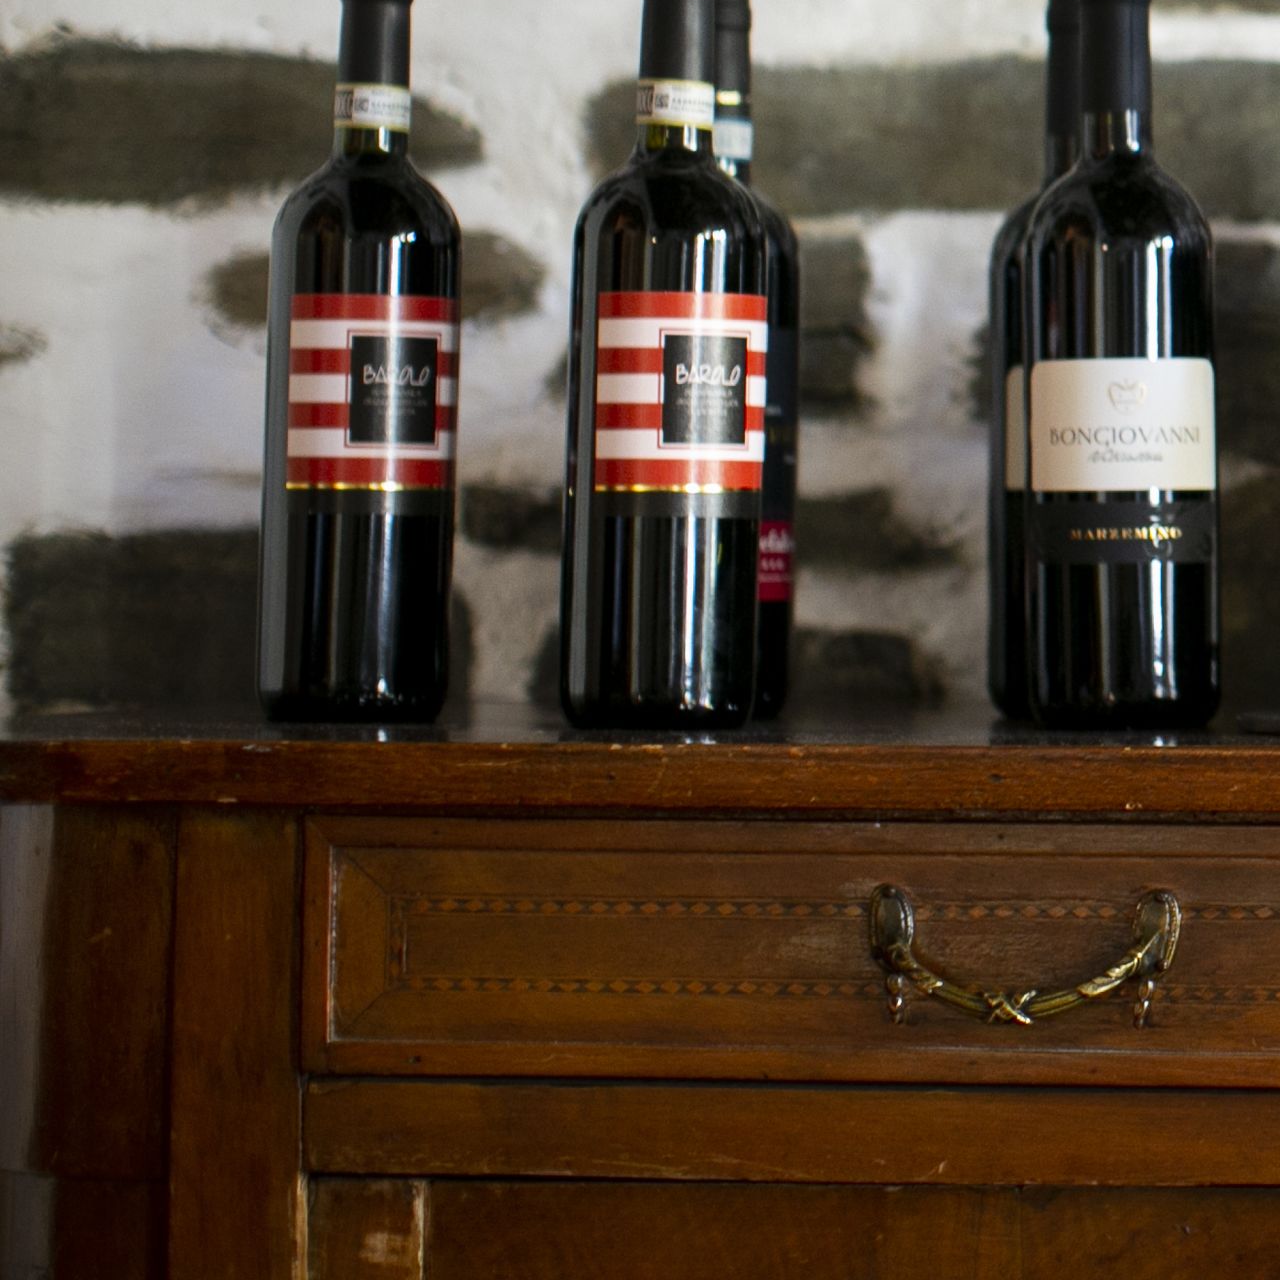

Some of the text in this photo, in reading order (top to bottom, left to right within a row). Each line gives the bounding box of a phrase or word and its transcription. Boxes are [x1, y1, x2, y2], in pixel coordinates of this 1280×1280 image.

[362, 363, 431, 387] BAOLO
[675, 362, 742, 387] BAROLO
[1049, 426, 1201, 447] BONGIOVANNI
